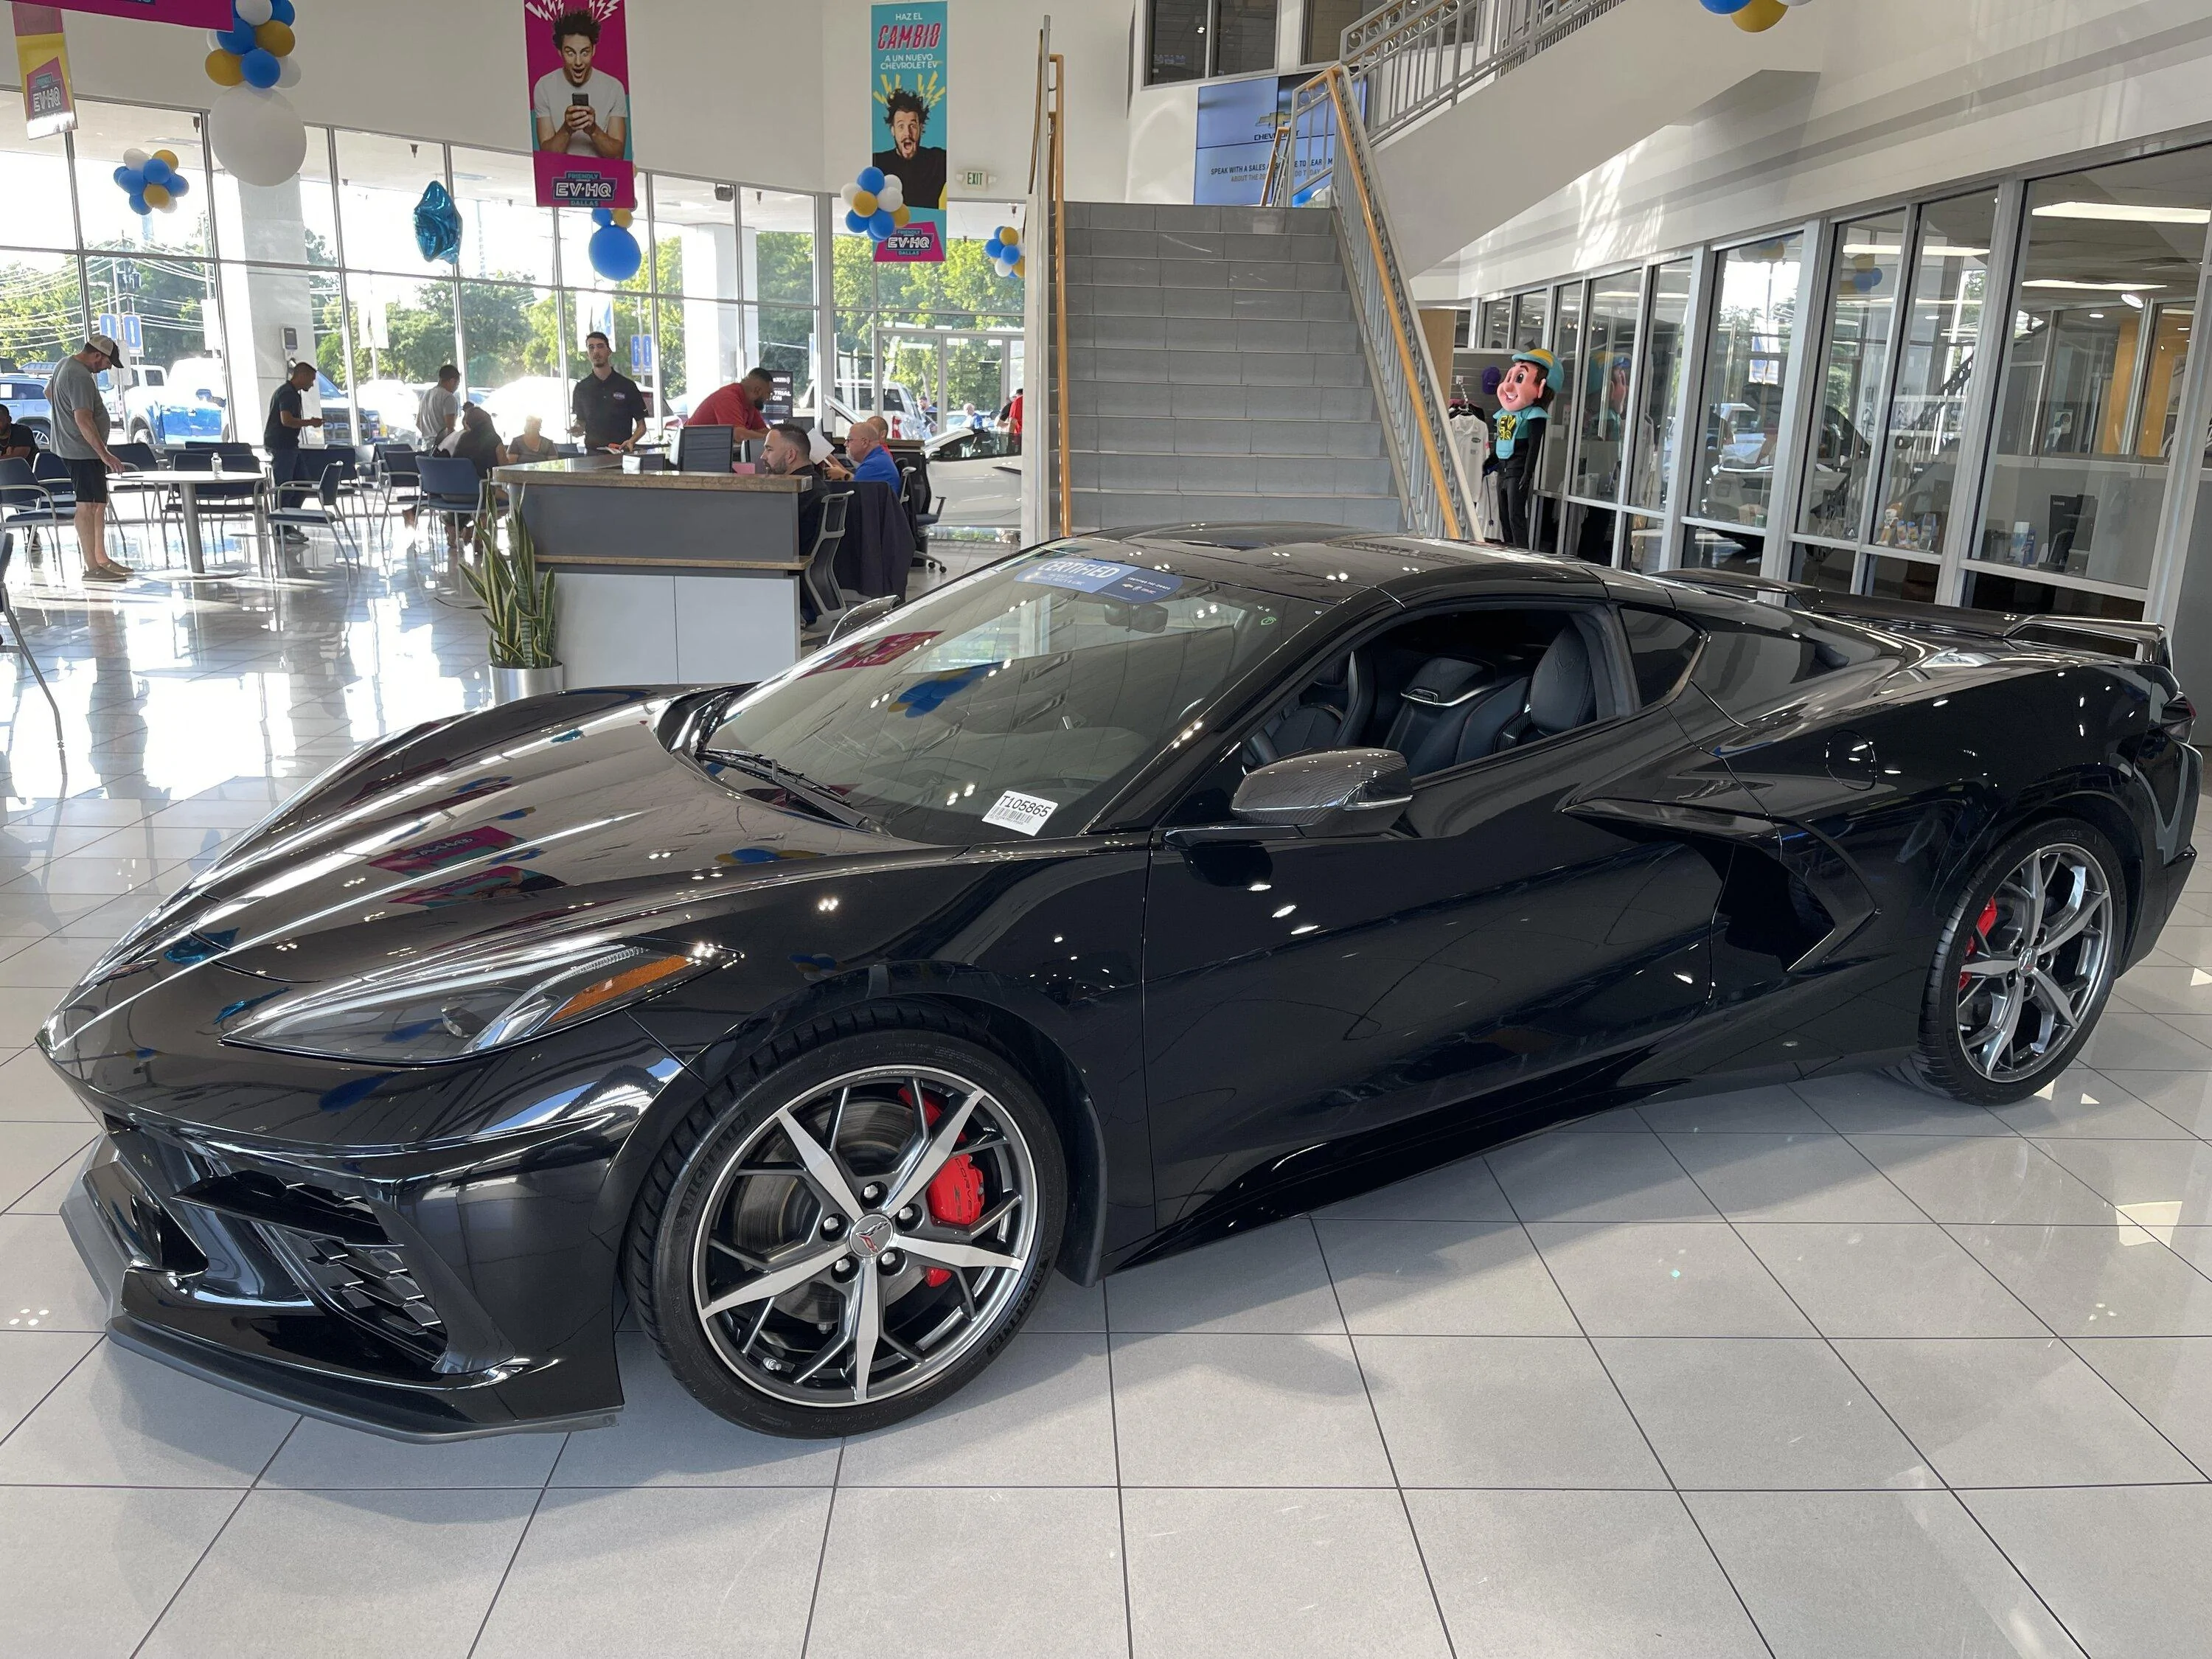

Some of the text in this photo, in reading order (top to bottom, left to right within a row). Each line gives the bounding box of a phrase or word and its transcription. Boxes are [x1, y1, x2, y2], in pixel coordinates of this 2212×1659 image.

[877, 22, 941, 50] CAMBIO
[880, 60, 937, 70] CHEVROLET EV
[967, 172, 983, 185] EXIT
[1211, 167, 1228, 175] SPEAK
[1248, 164, 1266, 172] SALES
[1231, 174, 1248, 182] ABOUT
[1037, 561, 1121, 579] CERTIFIED
[999, 796, 1052, 817] T105865
[682, 1113, 748, 1211] MICHELIN
[954, 1158, 973, 1222] CORVET
